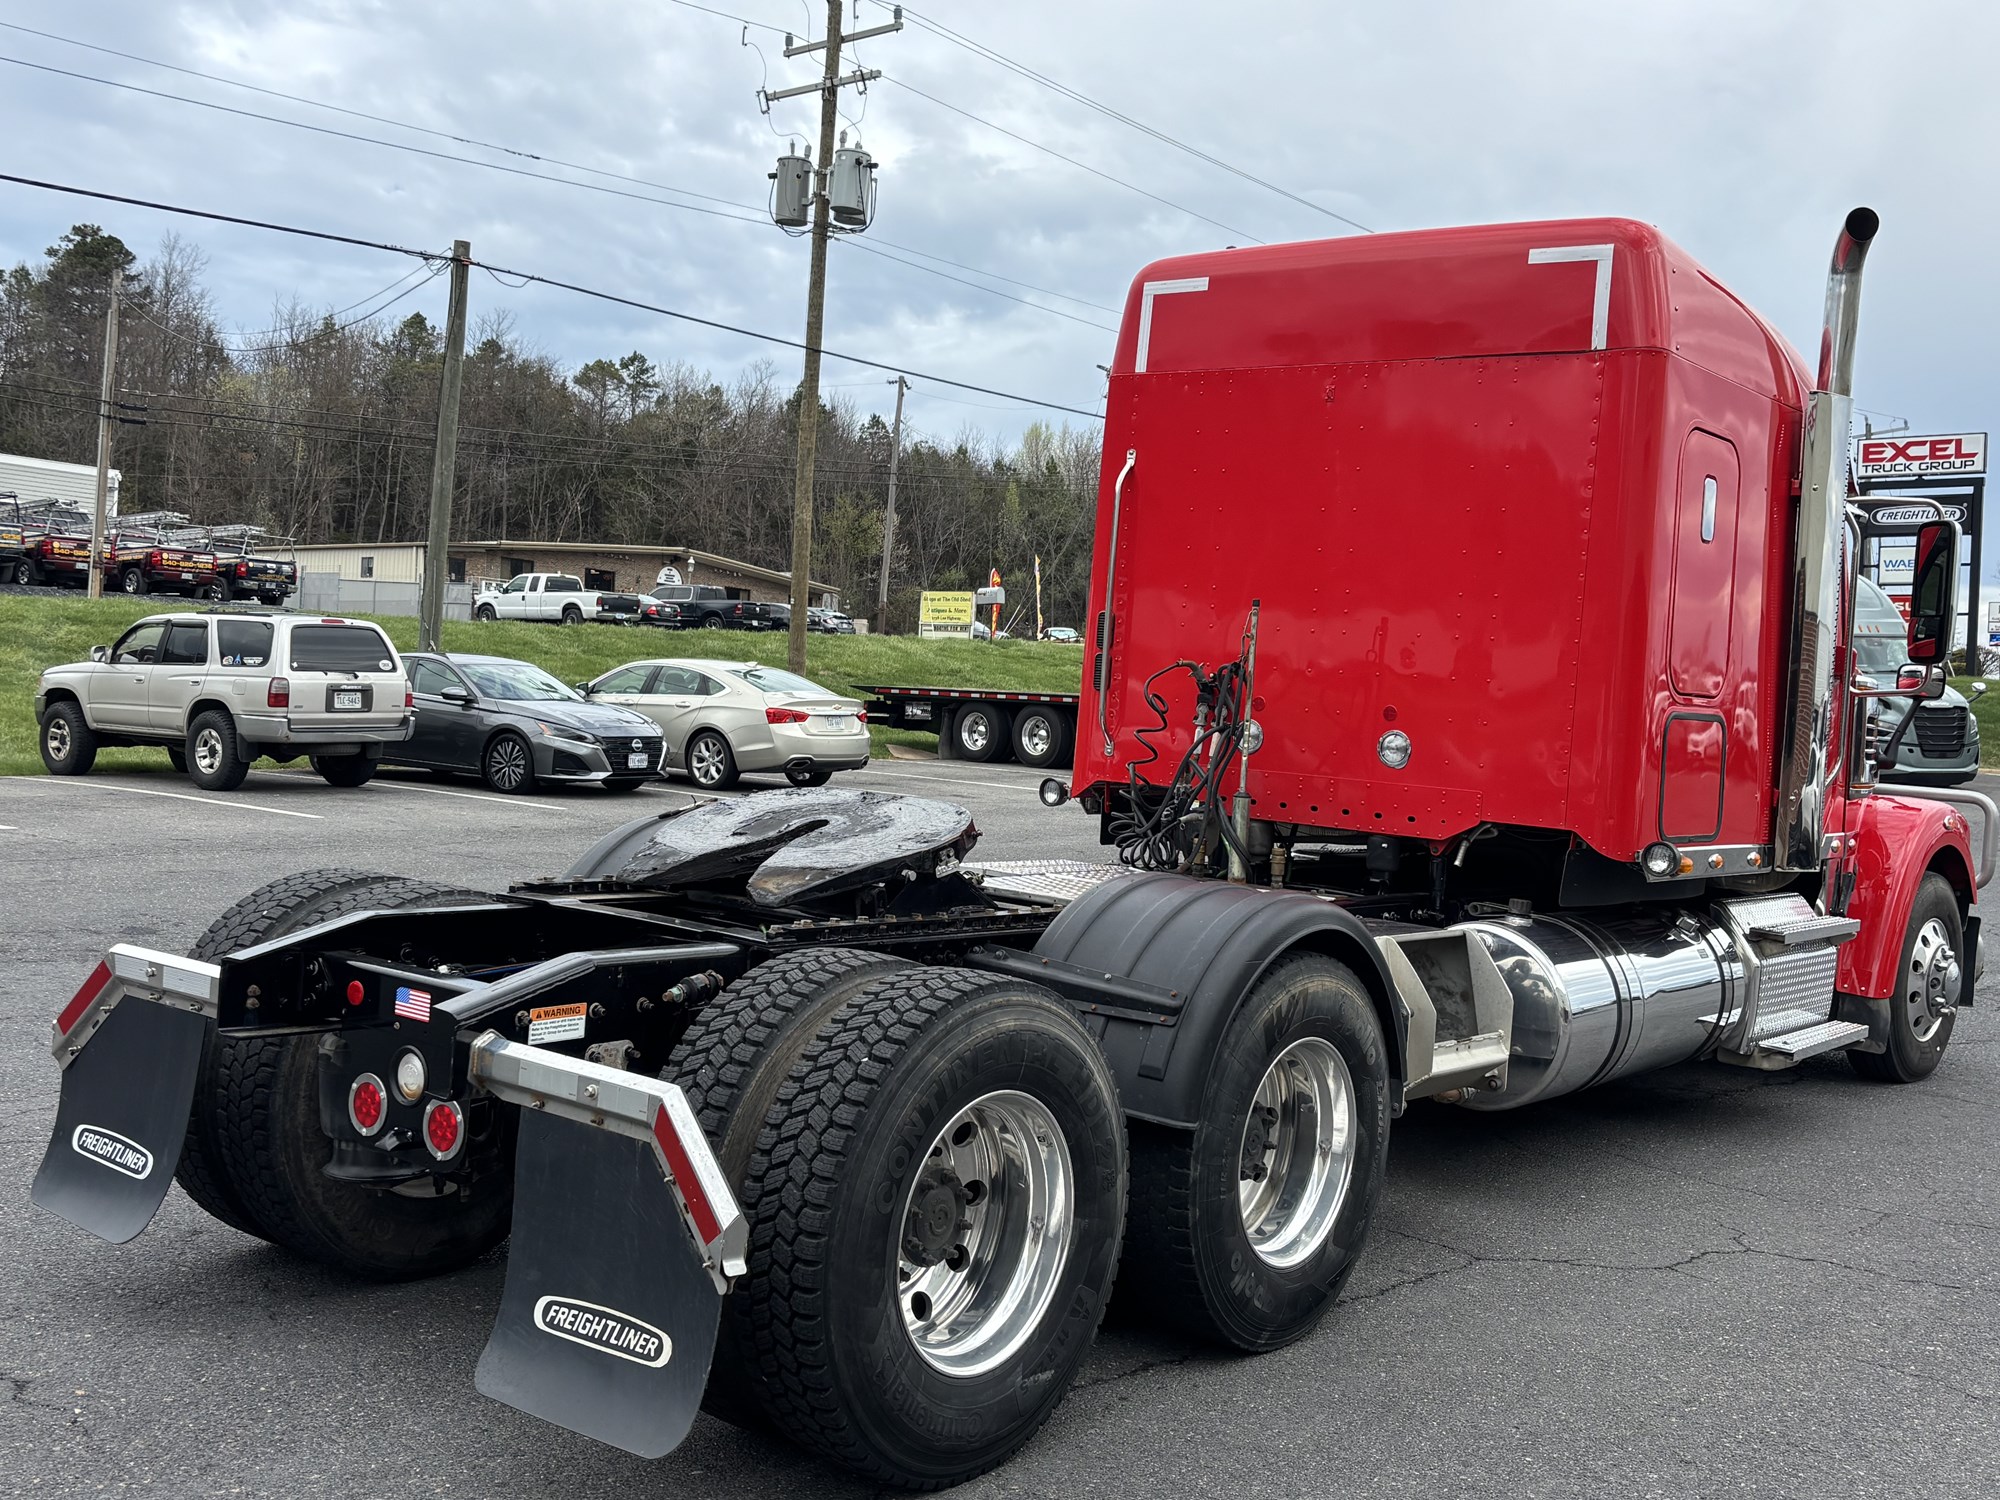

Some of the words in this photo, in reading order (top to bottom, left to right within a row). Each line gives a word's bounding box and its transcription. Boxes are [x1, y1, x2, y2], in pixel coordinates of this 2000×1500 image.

[1862, 438, 1979, 464] EXCEL
[1862, 462, 1914, 474] TRUCK
[1918, 459, 1975, 471] GROUP
[336, 696, 360, 705] TLC-5443
[543, 1006, 581, 1018] WARNING
[79, 1131, 147, 1172] FREIGHTLINER
[545, 1305, 659, 1357] FREIGHTLINER
